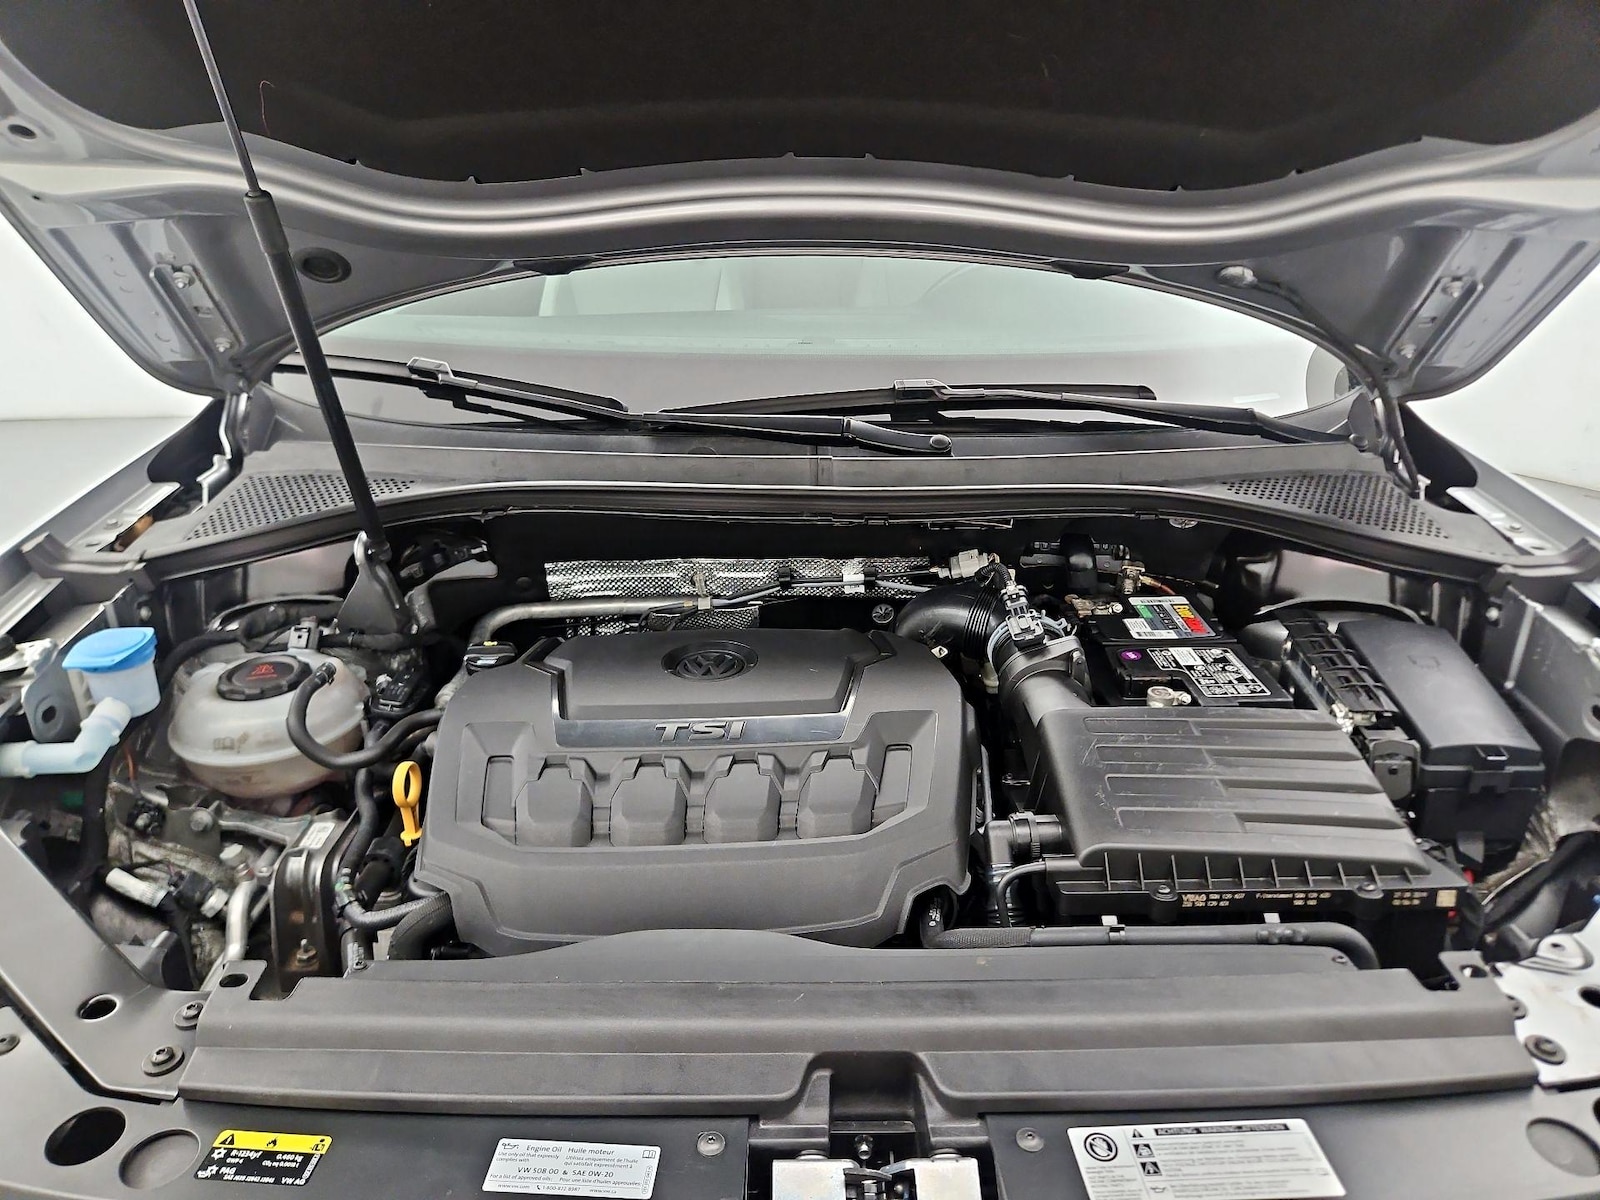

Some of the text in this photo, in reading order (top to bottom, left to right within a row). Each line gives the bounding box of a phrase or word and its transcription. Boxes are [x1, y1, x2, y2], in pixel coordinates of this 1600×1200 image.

[655, 720, 747, 742] TSI
[526, 1145, 550, 1153] Engine
[230, 1149, 263, 1159] R-1234yf
[219, 1166, 237, 1174] PAG
